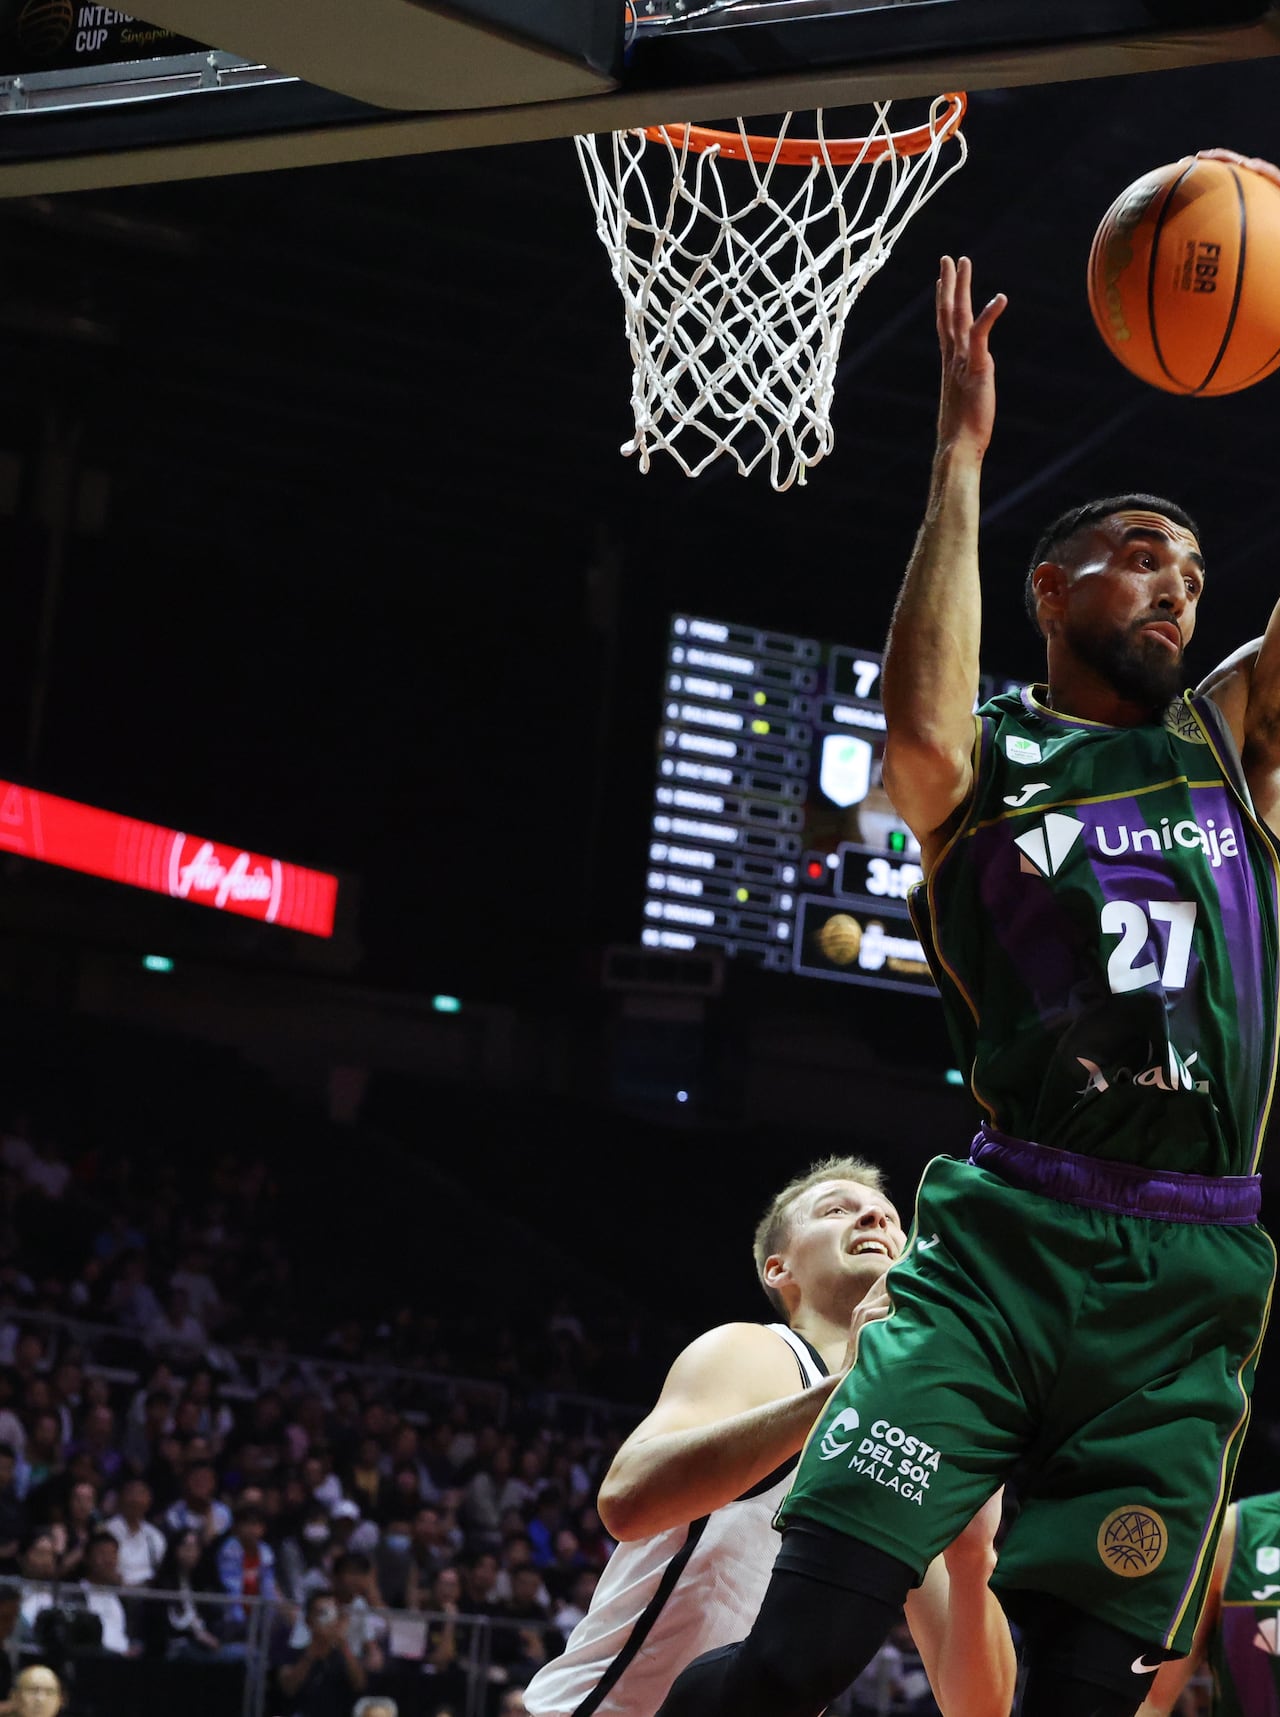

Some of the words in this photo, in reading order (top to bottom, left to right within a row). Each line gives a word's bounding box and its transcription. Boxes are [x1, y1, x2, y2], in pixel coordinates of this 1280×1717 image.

[76, 29, 108, 52] CUP
[1101, 900, 1197, 994] 27
[857, 1438, 894, 1468] DEL
[897, 1458, 931, 1489] SOL
[870, 1419, 942, 1472] COSTA
[848, 1455, 924, 1506] MÁLAGA
